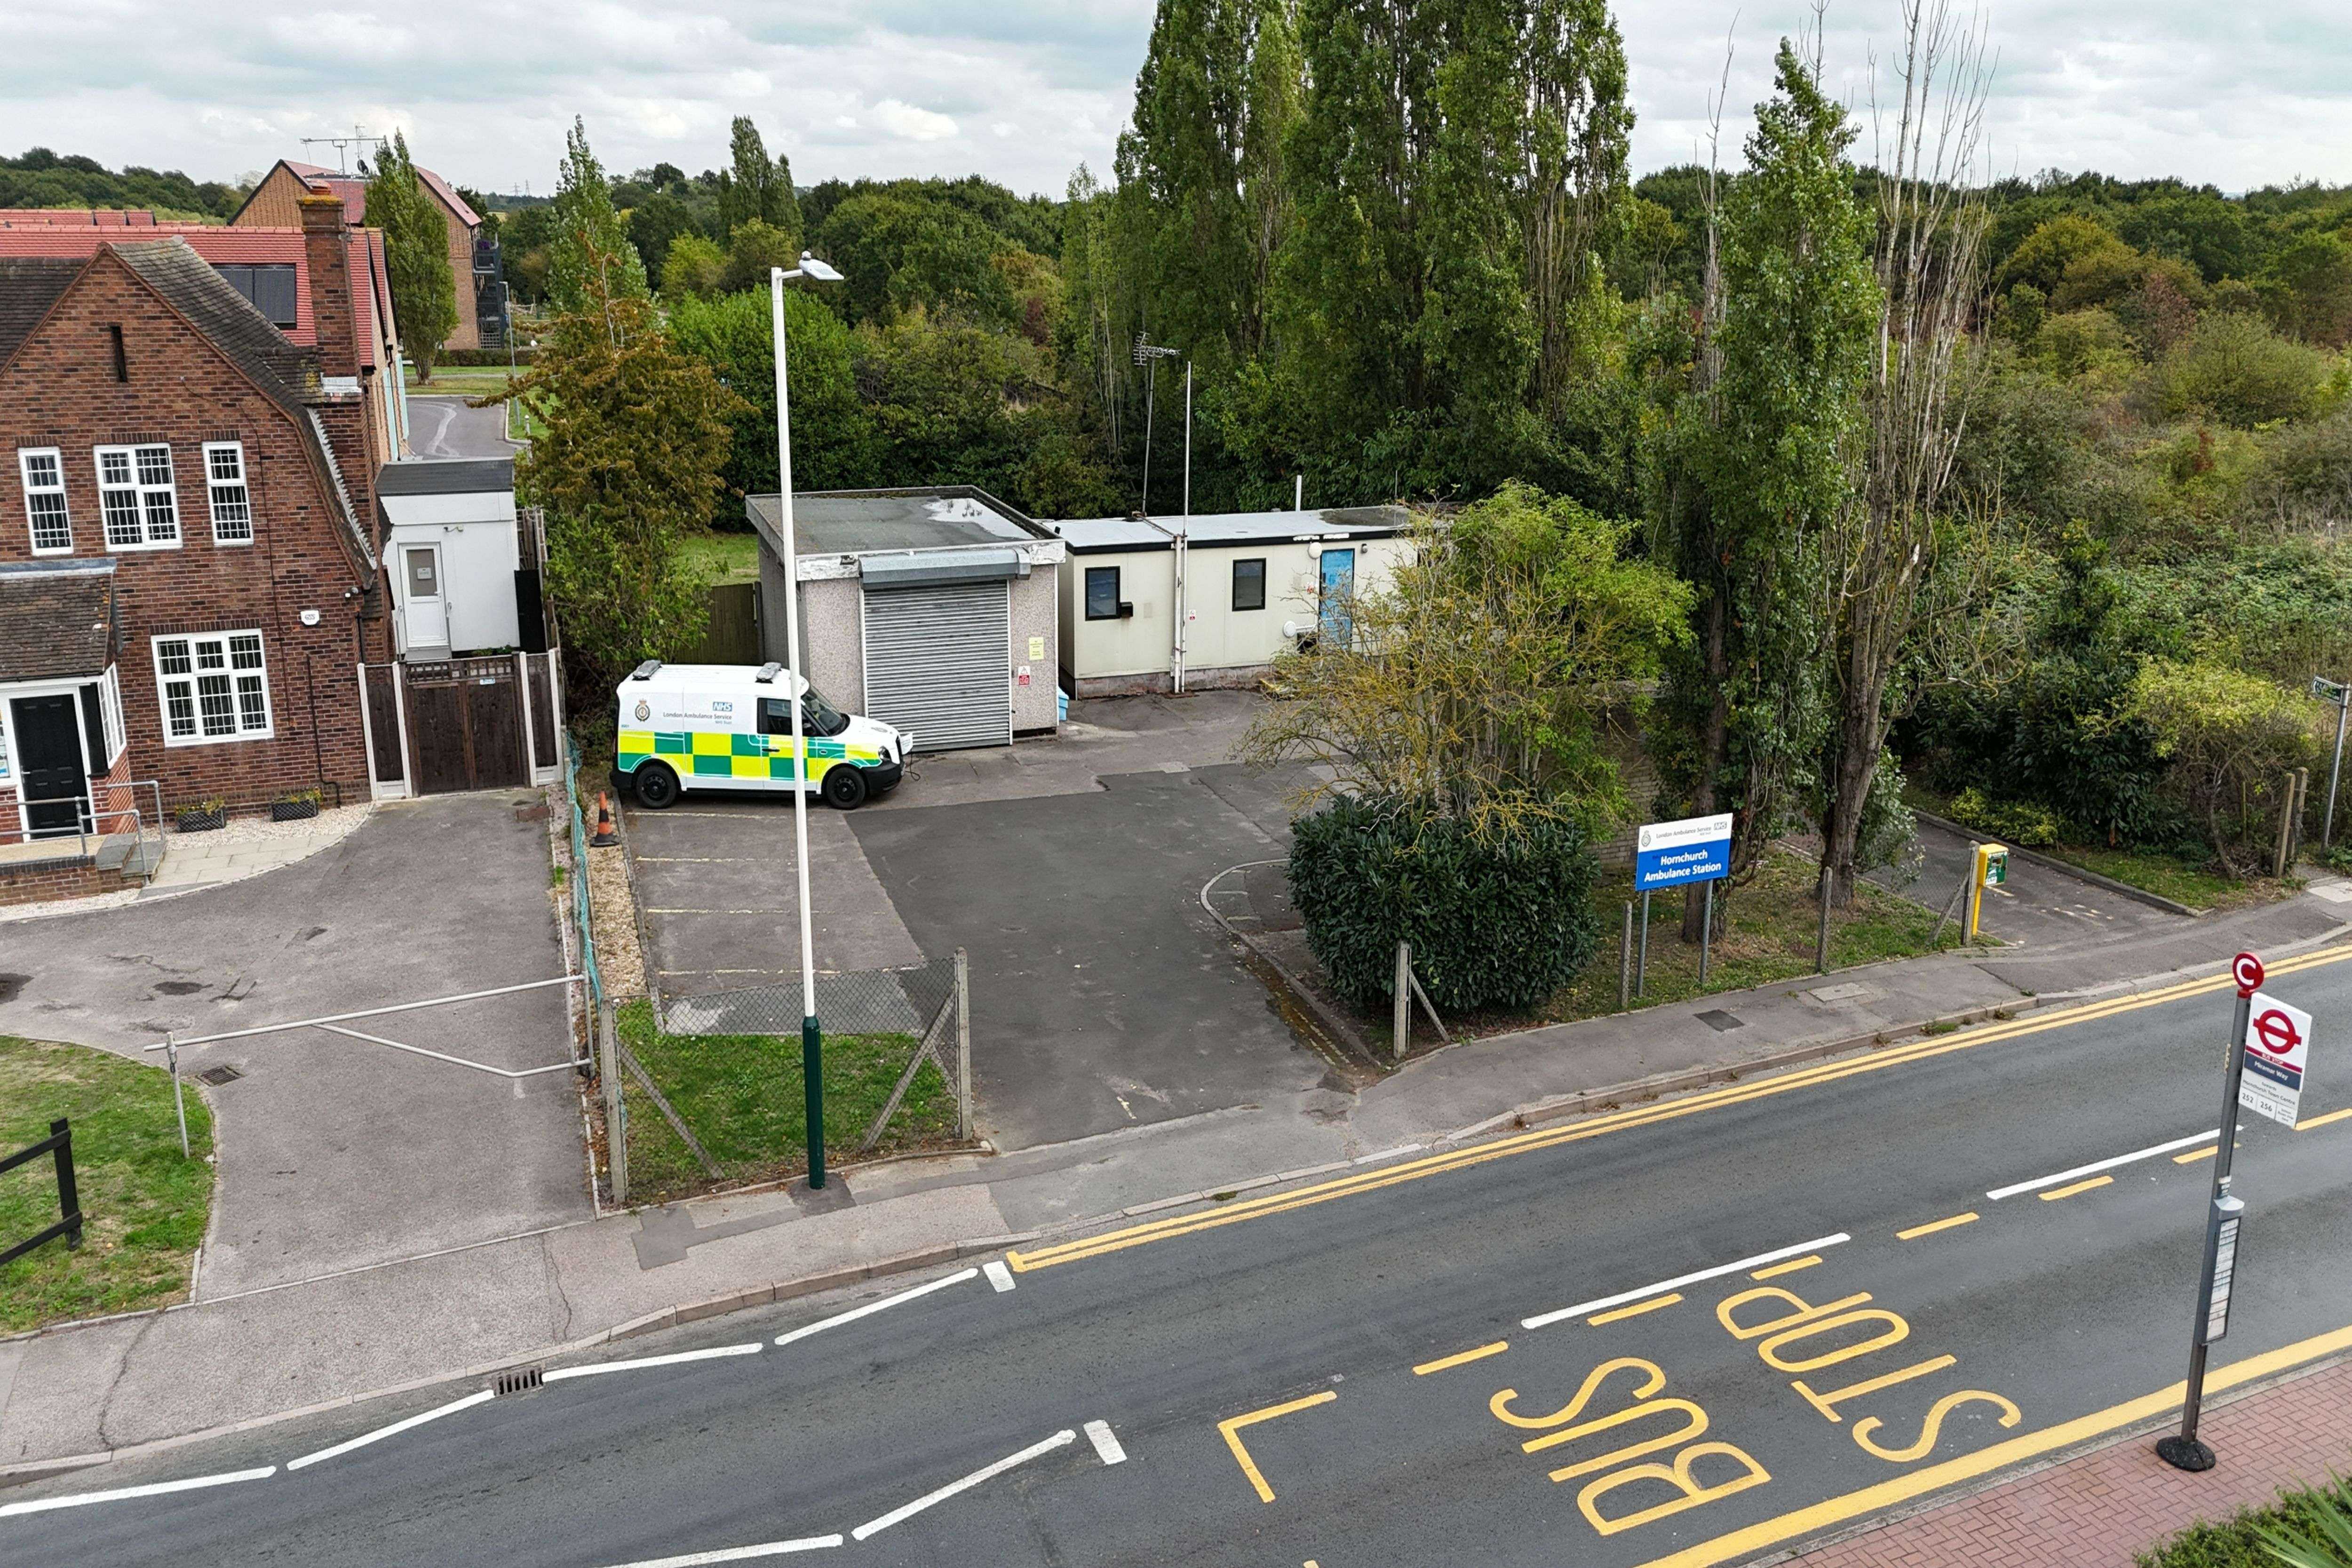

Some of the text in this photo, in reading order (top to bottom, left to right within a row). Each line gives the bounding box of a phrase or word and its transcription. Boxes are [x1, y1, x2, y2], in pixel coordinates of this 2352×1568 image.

[714, 702, 732, 711] NHS
[1661, 849, 1708, 866] Hornchurch
[1644, 862, 1721, 882] Ambulance Station
[2237, 958, 2256, 985] C
[2276, 1070, 2288, 1081] Way
[2242, 1093, 2254, 1103] 252
[2280, 1095, 2295, 1105] Centre
[2260, 1101, 2273, 1112] 256
[1716, 1286, 2022, 1463] STOP
[1489, 1357, 1772, 1536] BUS
